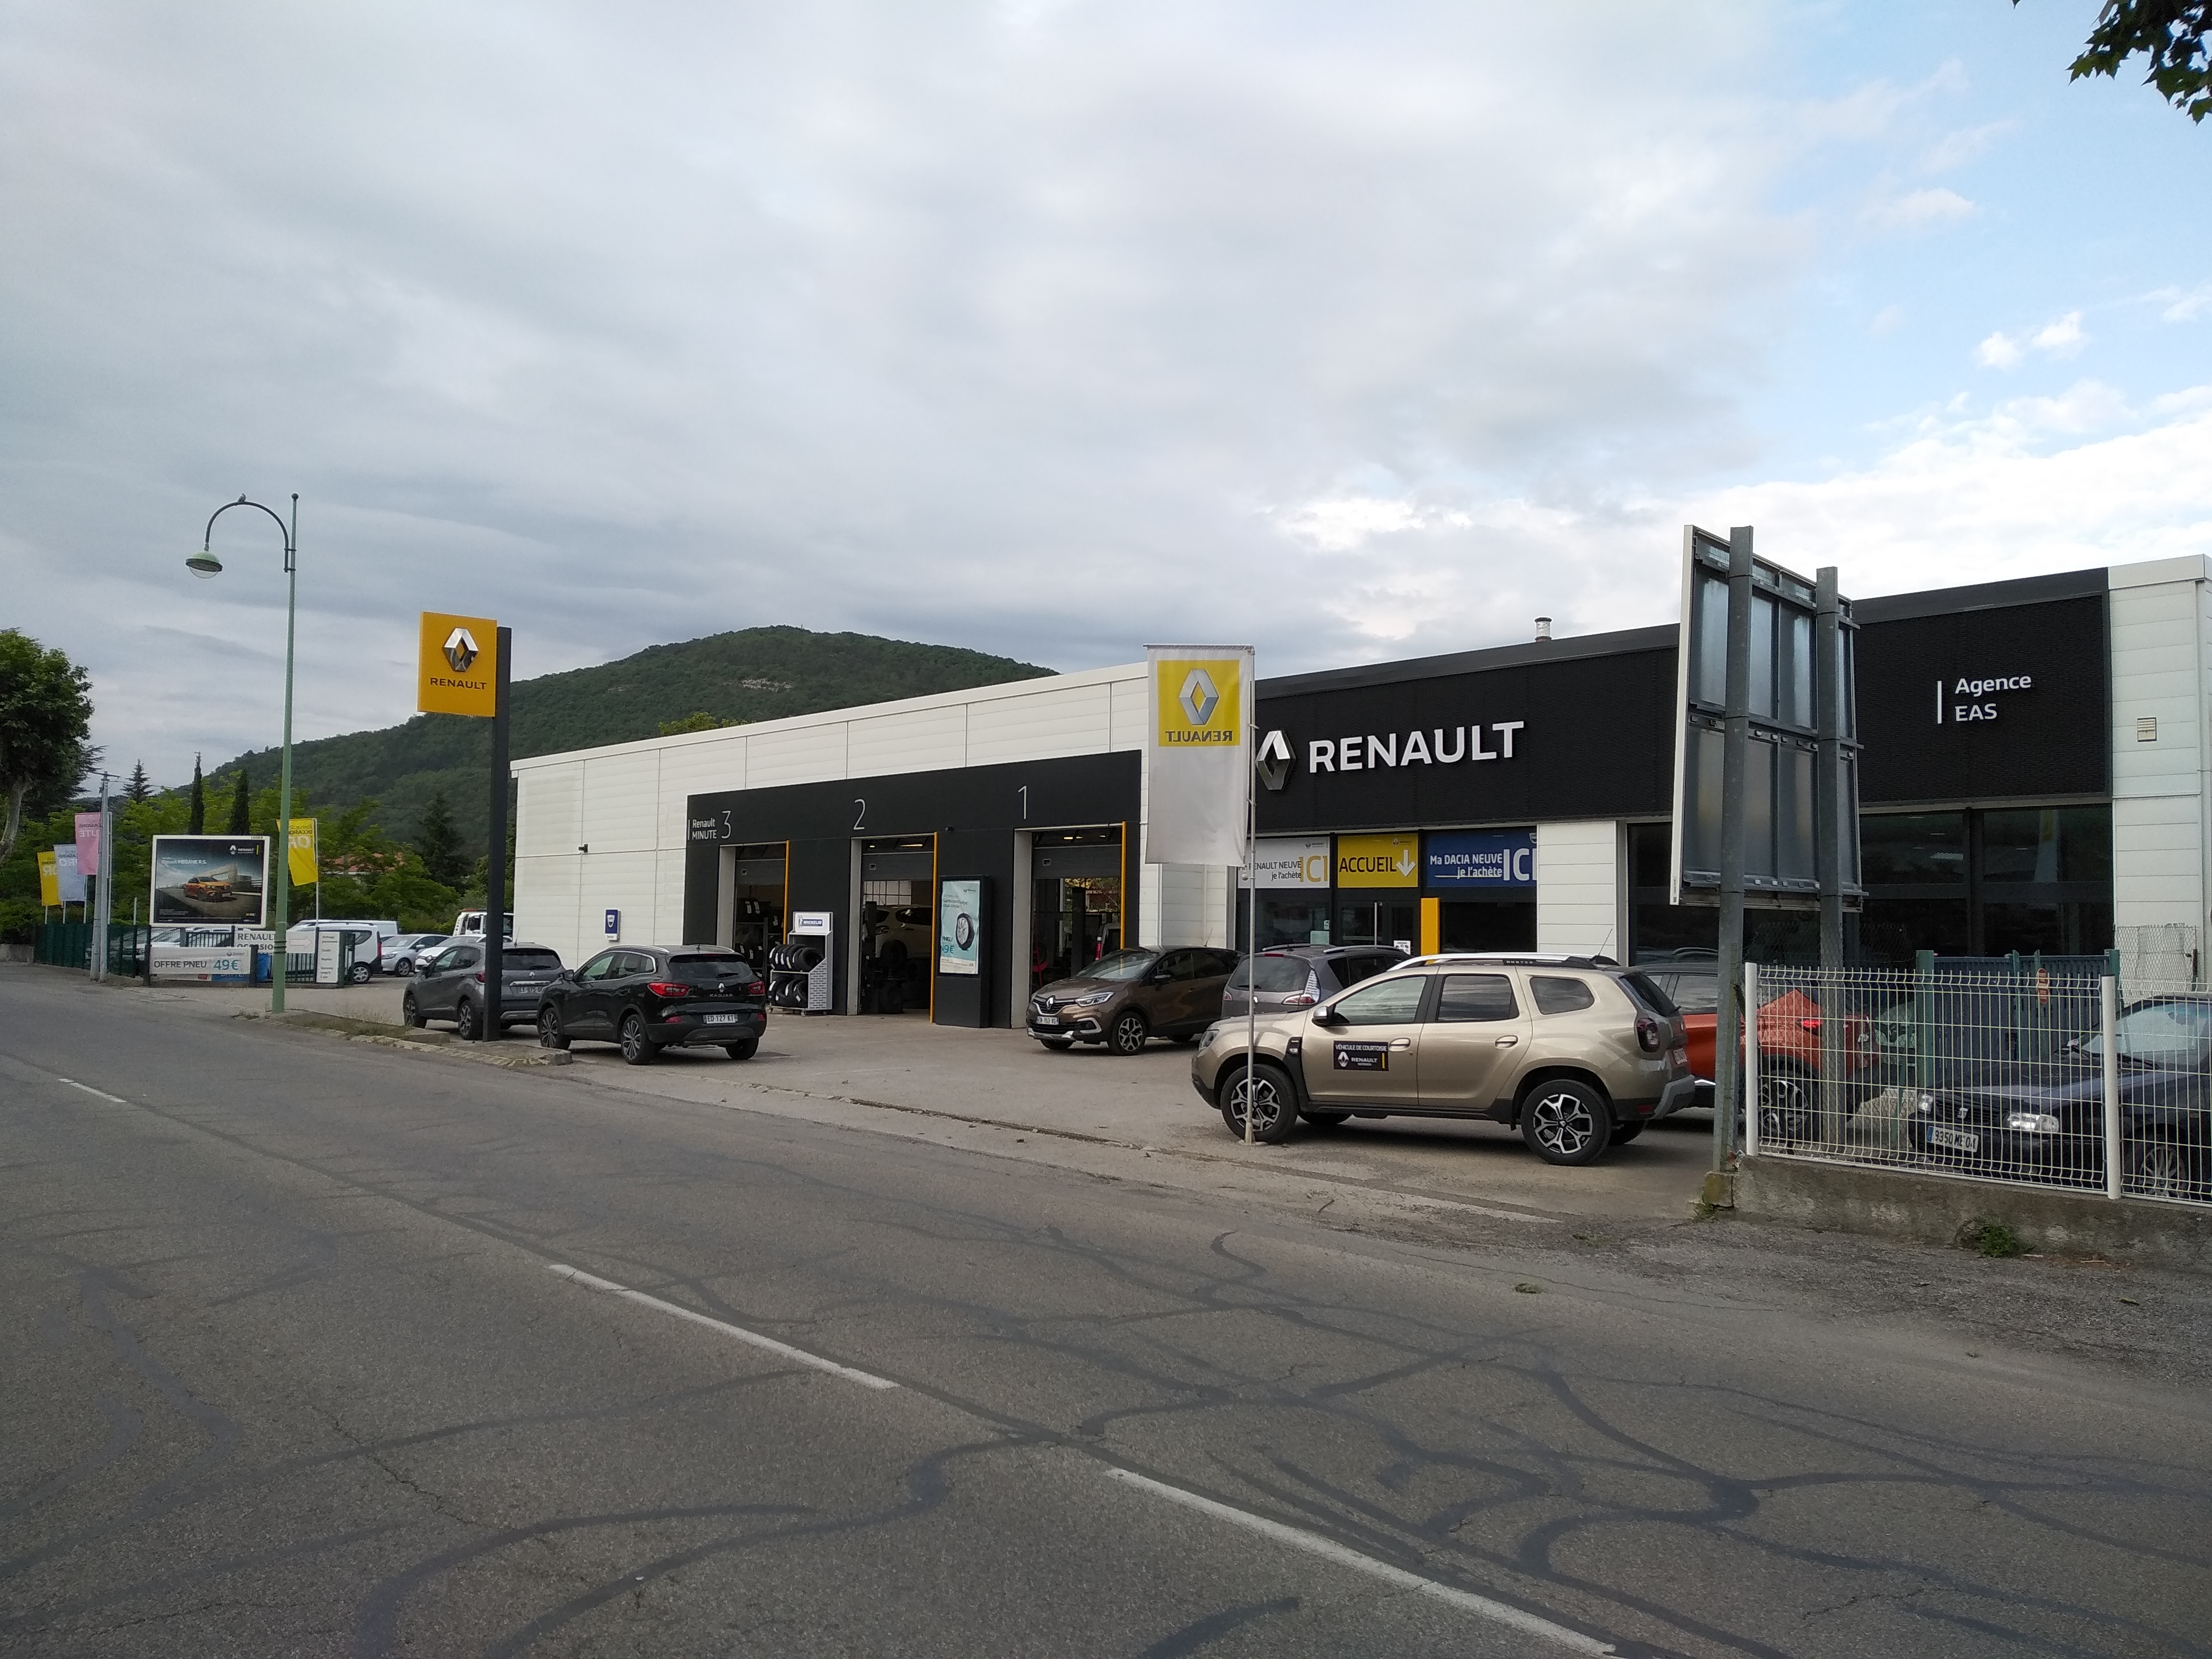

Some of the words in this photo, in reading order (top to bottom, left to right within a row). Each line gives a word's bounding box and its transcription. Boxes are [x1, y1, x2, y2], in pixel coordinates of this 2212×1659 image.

[430, 677, 487, 690] RENAULT
[1954, 676, 2032, 697] Agence
[1954, 703, 1997, 722] EAS
[1309, 721, 1524, 773] RENAULT
[1018, 785, 1027, 820] 1
[853, 799, 865, 830] 2
[692, 817, 716, 828] Renault
[721, 811, 731, 839] 3
[692, 830, 717, 840] MINUTE
[1279, 860, 1302, 869] NEUVE
[1339, 857, 1397, 873] ACCUEIL
[1430, 855, 1442, 865] Ma
[1444, 854, 1470, 865] DACIA
[1472, 853, 1503, 864] NEUVE
[1271, 873, 1277, 881] je
[1457, 867, 1465, 879] je
[1468, 866, 1503, 877] l'achète
[213, 959, 239, 971] 49€
[1935, 1130, 1953, 1145] 9350
